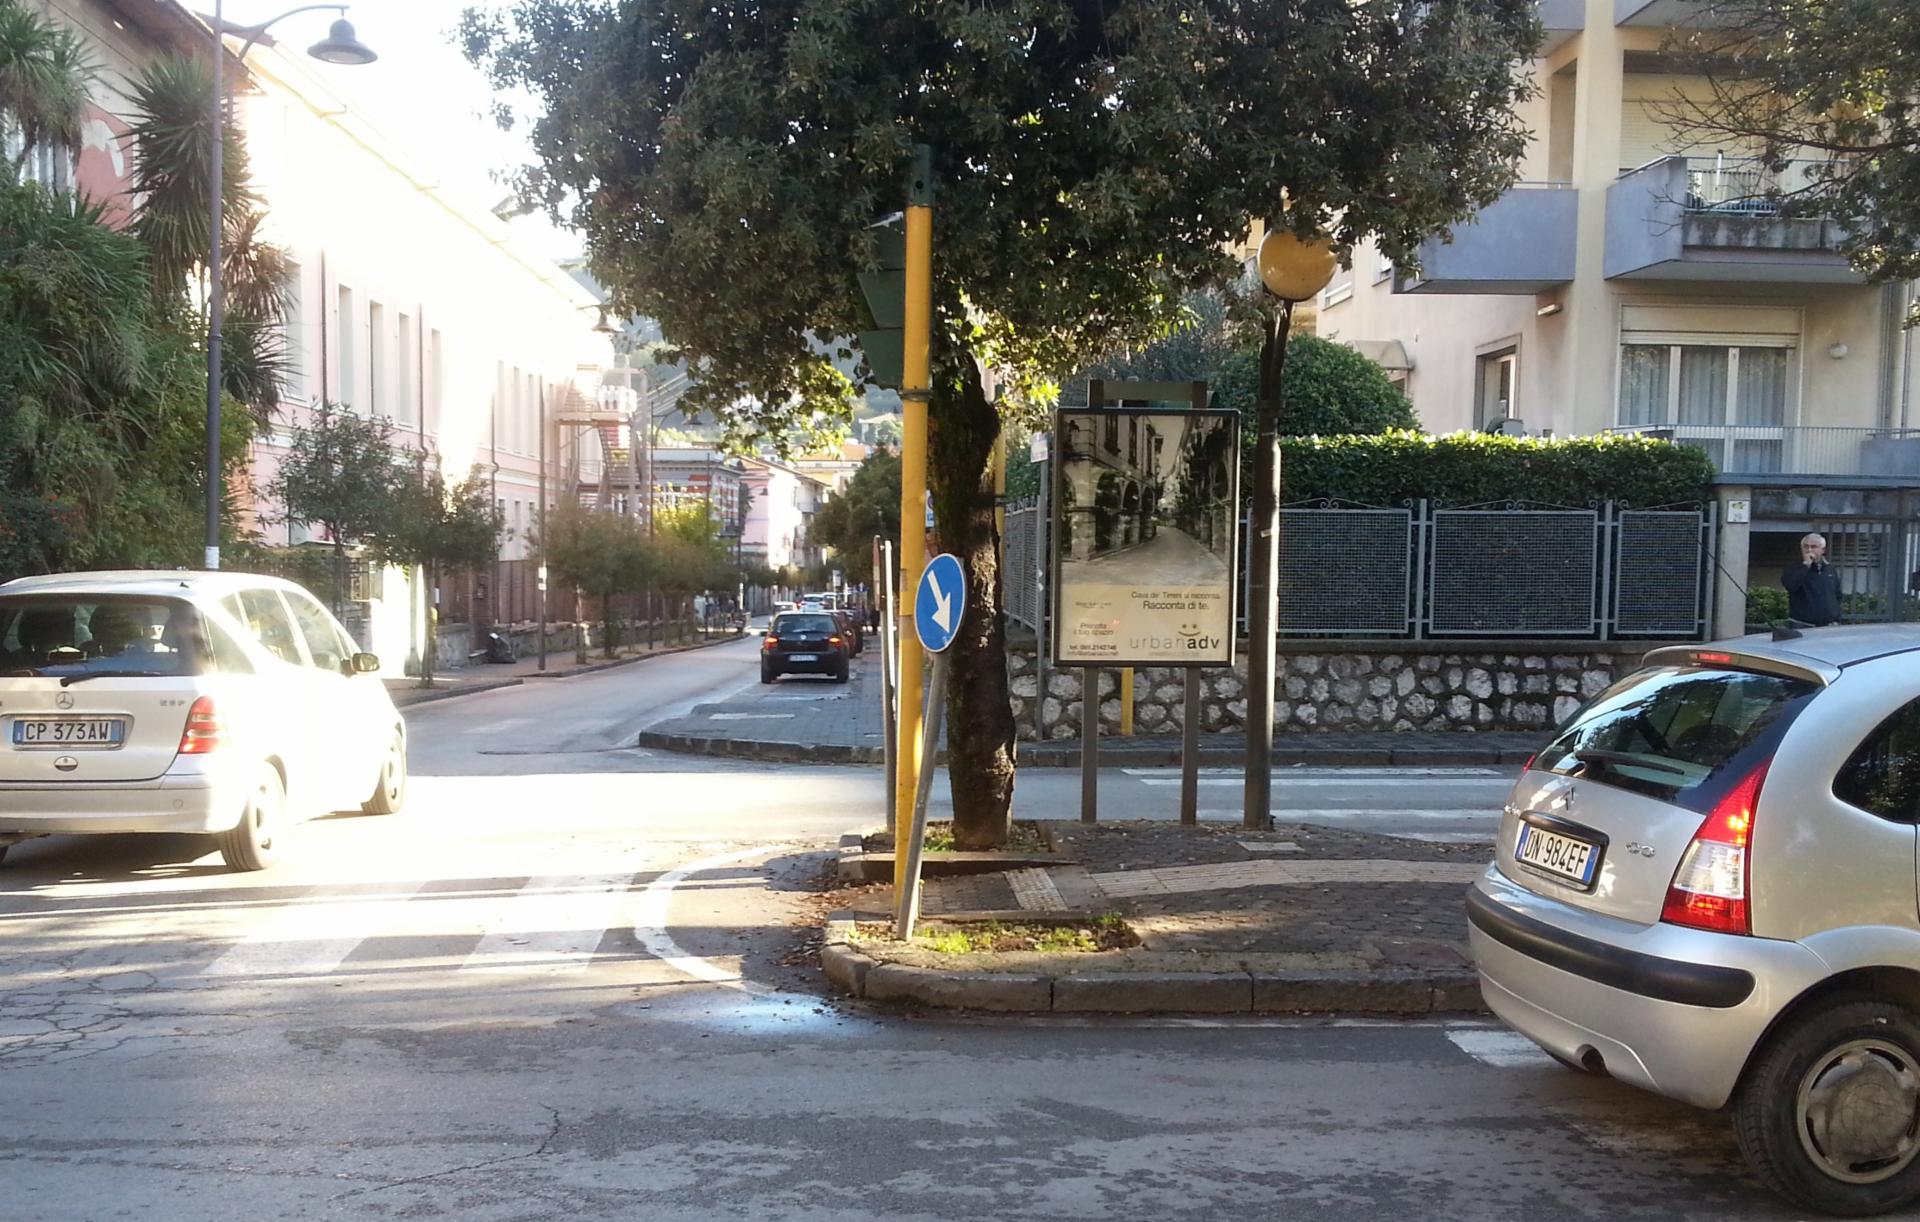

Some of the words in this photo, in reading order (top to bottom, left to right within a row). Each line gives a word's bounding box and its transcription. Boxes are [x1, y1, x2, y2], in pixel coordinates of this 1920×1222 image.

[1143, 600, 1186, 610] Racconta
[1187, 600, 1196, 610] di
[1129, 635, 1220, 649] urbanadv
[26, 723, 47, 740] CP
[54, 723, 109, 740] 373AW
[1524, 830, 1544, 861] DN
[1543, 836, 1589, 875] 984EF
